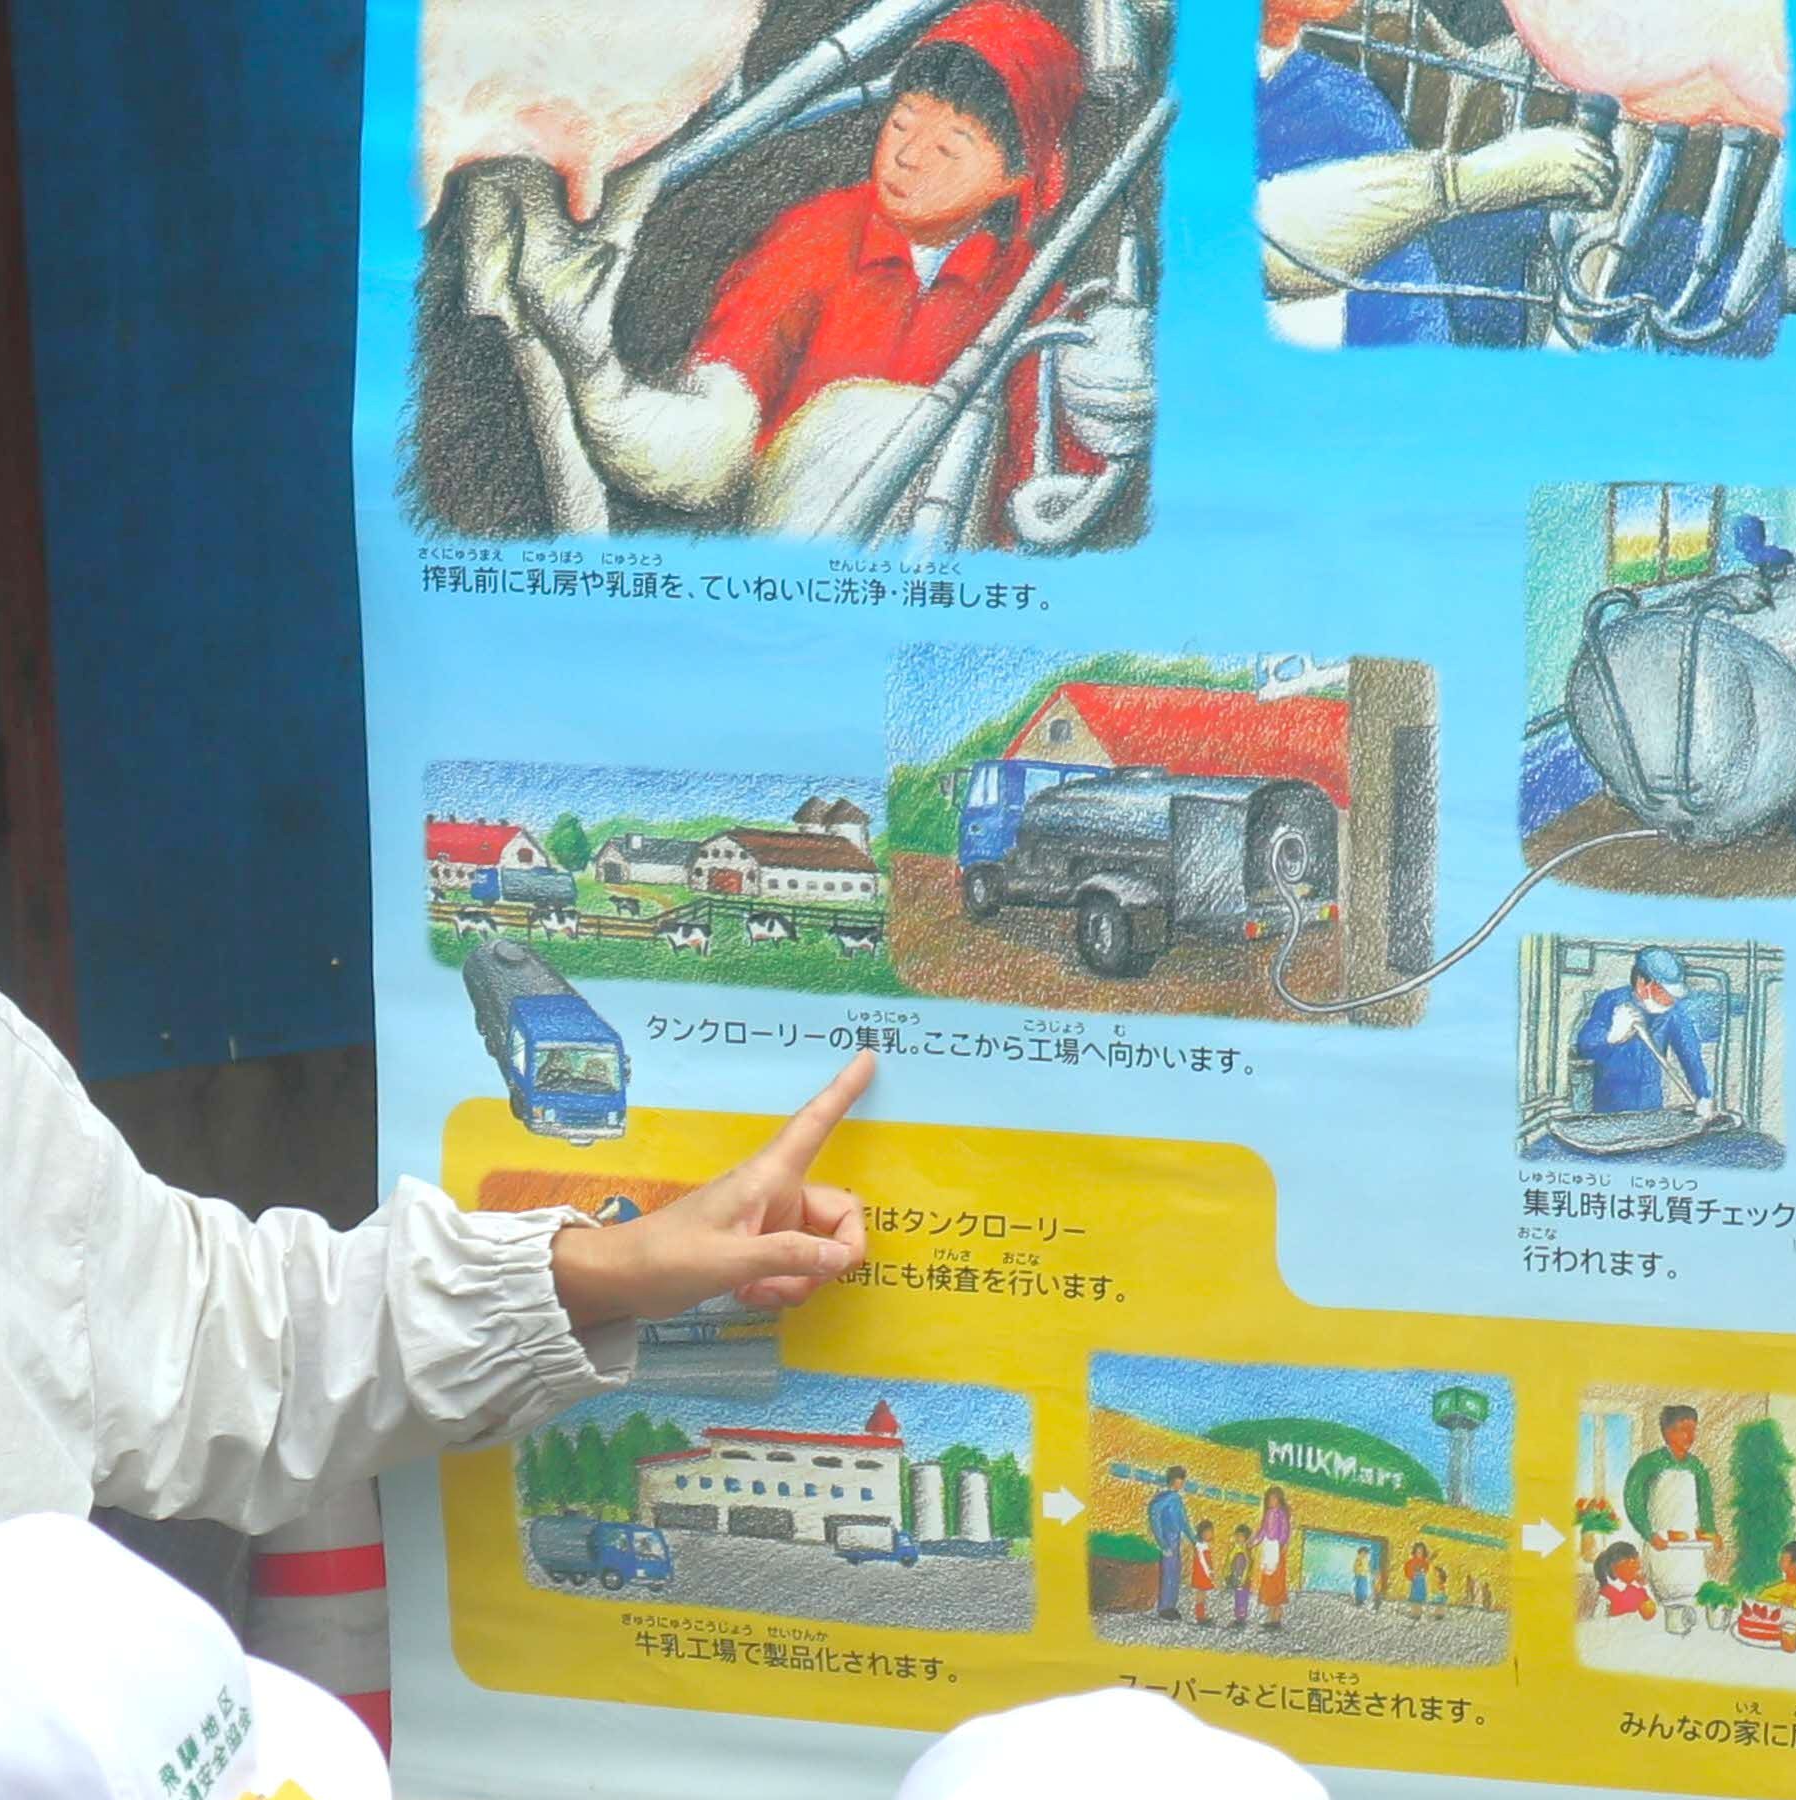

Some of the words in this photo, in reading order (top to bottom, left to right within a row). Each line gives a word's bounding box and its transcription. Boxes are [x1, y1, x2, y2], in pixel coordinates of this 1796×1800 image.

[836, 1261, 1125, 1303] 時にも検査を行います。
[1523, 1245, 1677, 1280] 行われます。
[635, 1631, 958, 1684] 牛乳工場で製品化されます。
